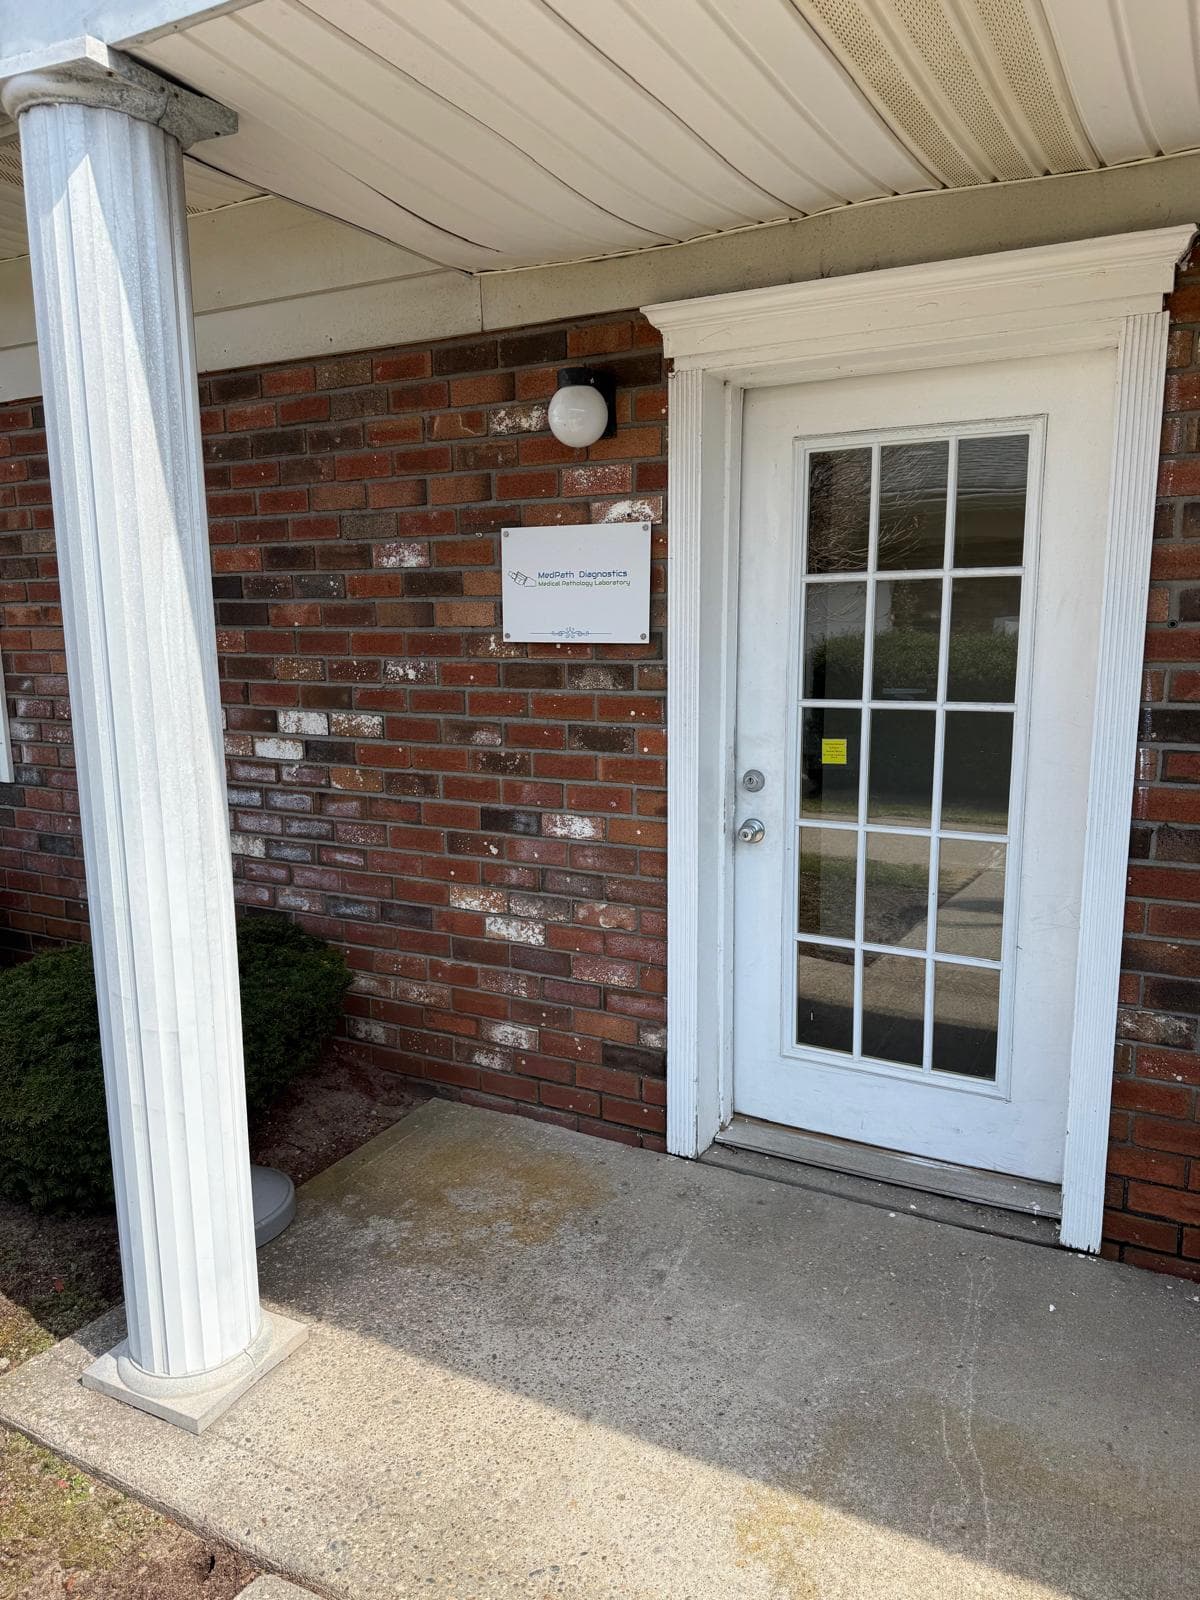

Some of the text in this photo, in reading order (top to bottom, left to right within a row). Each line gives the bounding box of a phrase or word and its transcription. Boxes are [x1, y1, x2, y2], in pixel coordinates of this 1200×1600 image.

[537, 570, 628, 579] MedPath Diagnostics
[594, 579, 631, 587] Laboratory
